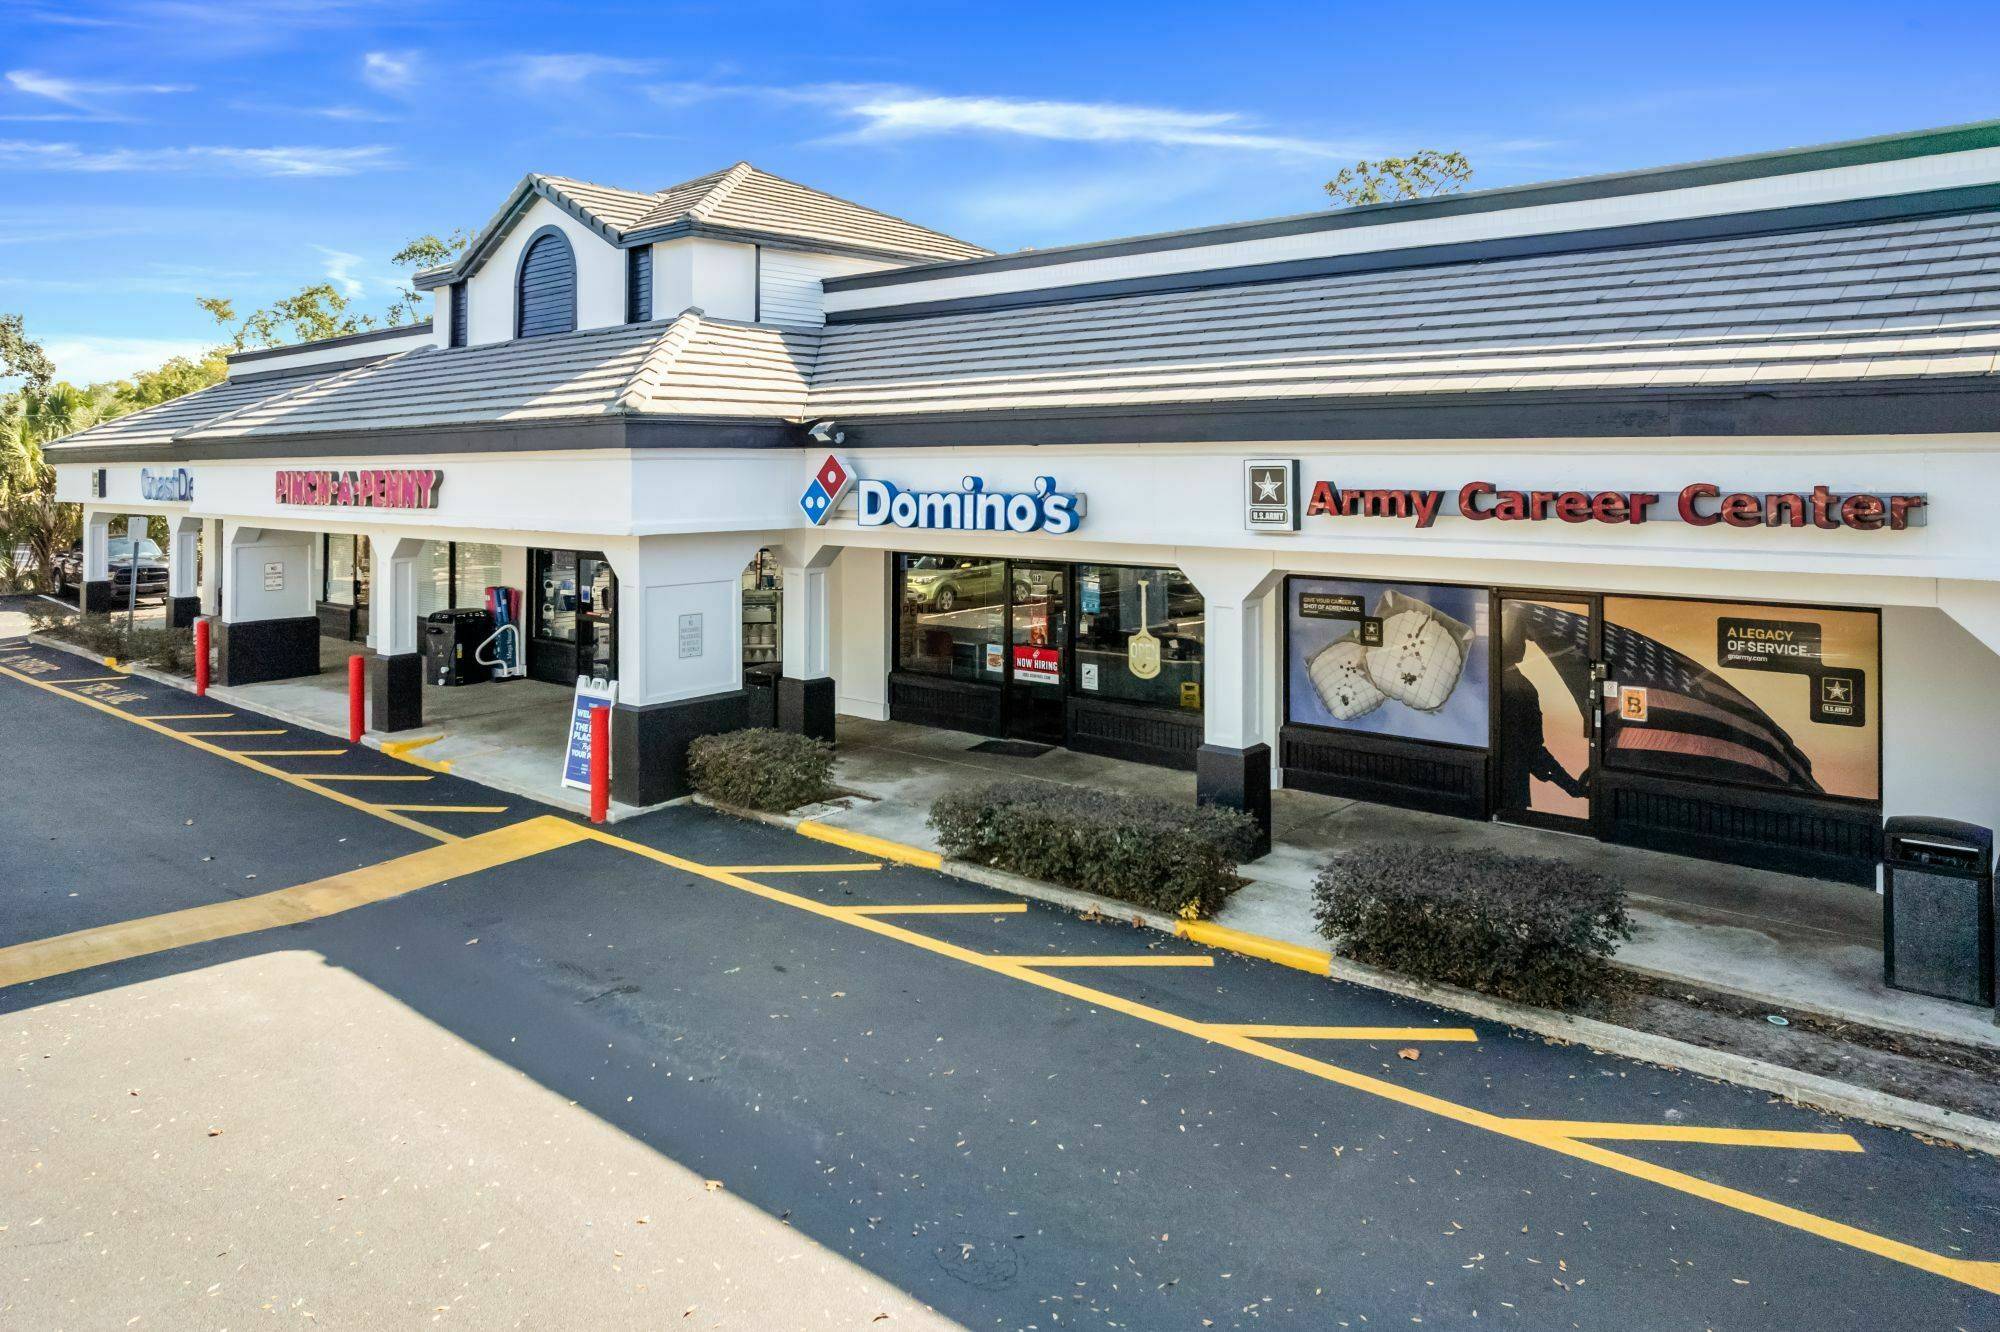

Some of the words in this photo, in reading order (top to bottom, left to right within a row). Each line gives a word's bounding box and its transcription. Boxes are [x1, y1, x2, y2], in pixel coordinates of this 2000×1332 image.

[141, 467, 194, 502] CoastDe
[858, 475, 1081, 534] Domino's
[1307, 481, 1445, 528] Army
[1458, 481, 1659, 525] Career
[1678, 483, 1926, 530] Center
[1727, 627, 1738, 638] A
[1739, 628, 1794, 642] LEGACY
[1727, 640, 1745, 652] OF
[1016, 657, 1033, 668] NOW
[1034, 659, 1058, 671] HIRING
[1727, 653, 1768, 662] goarmy.com
[1627, 696, 1642, 714] B
